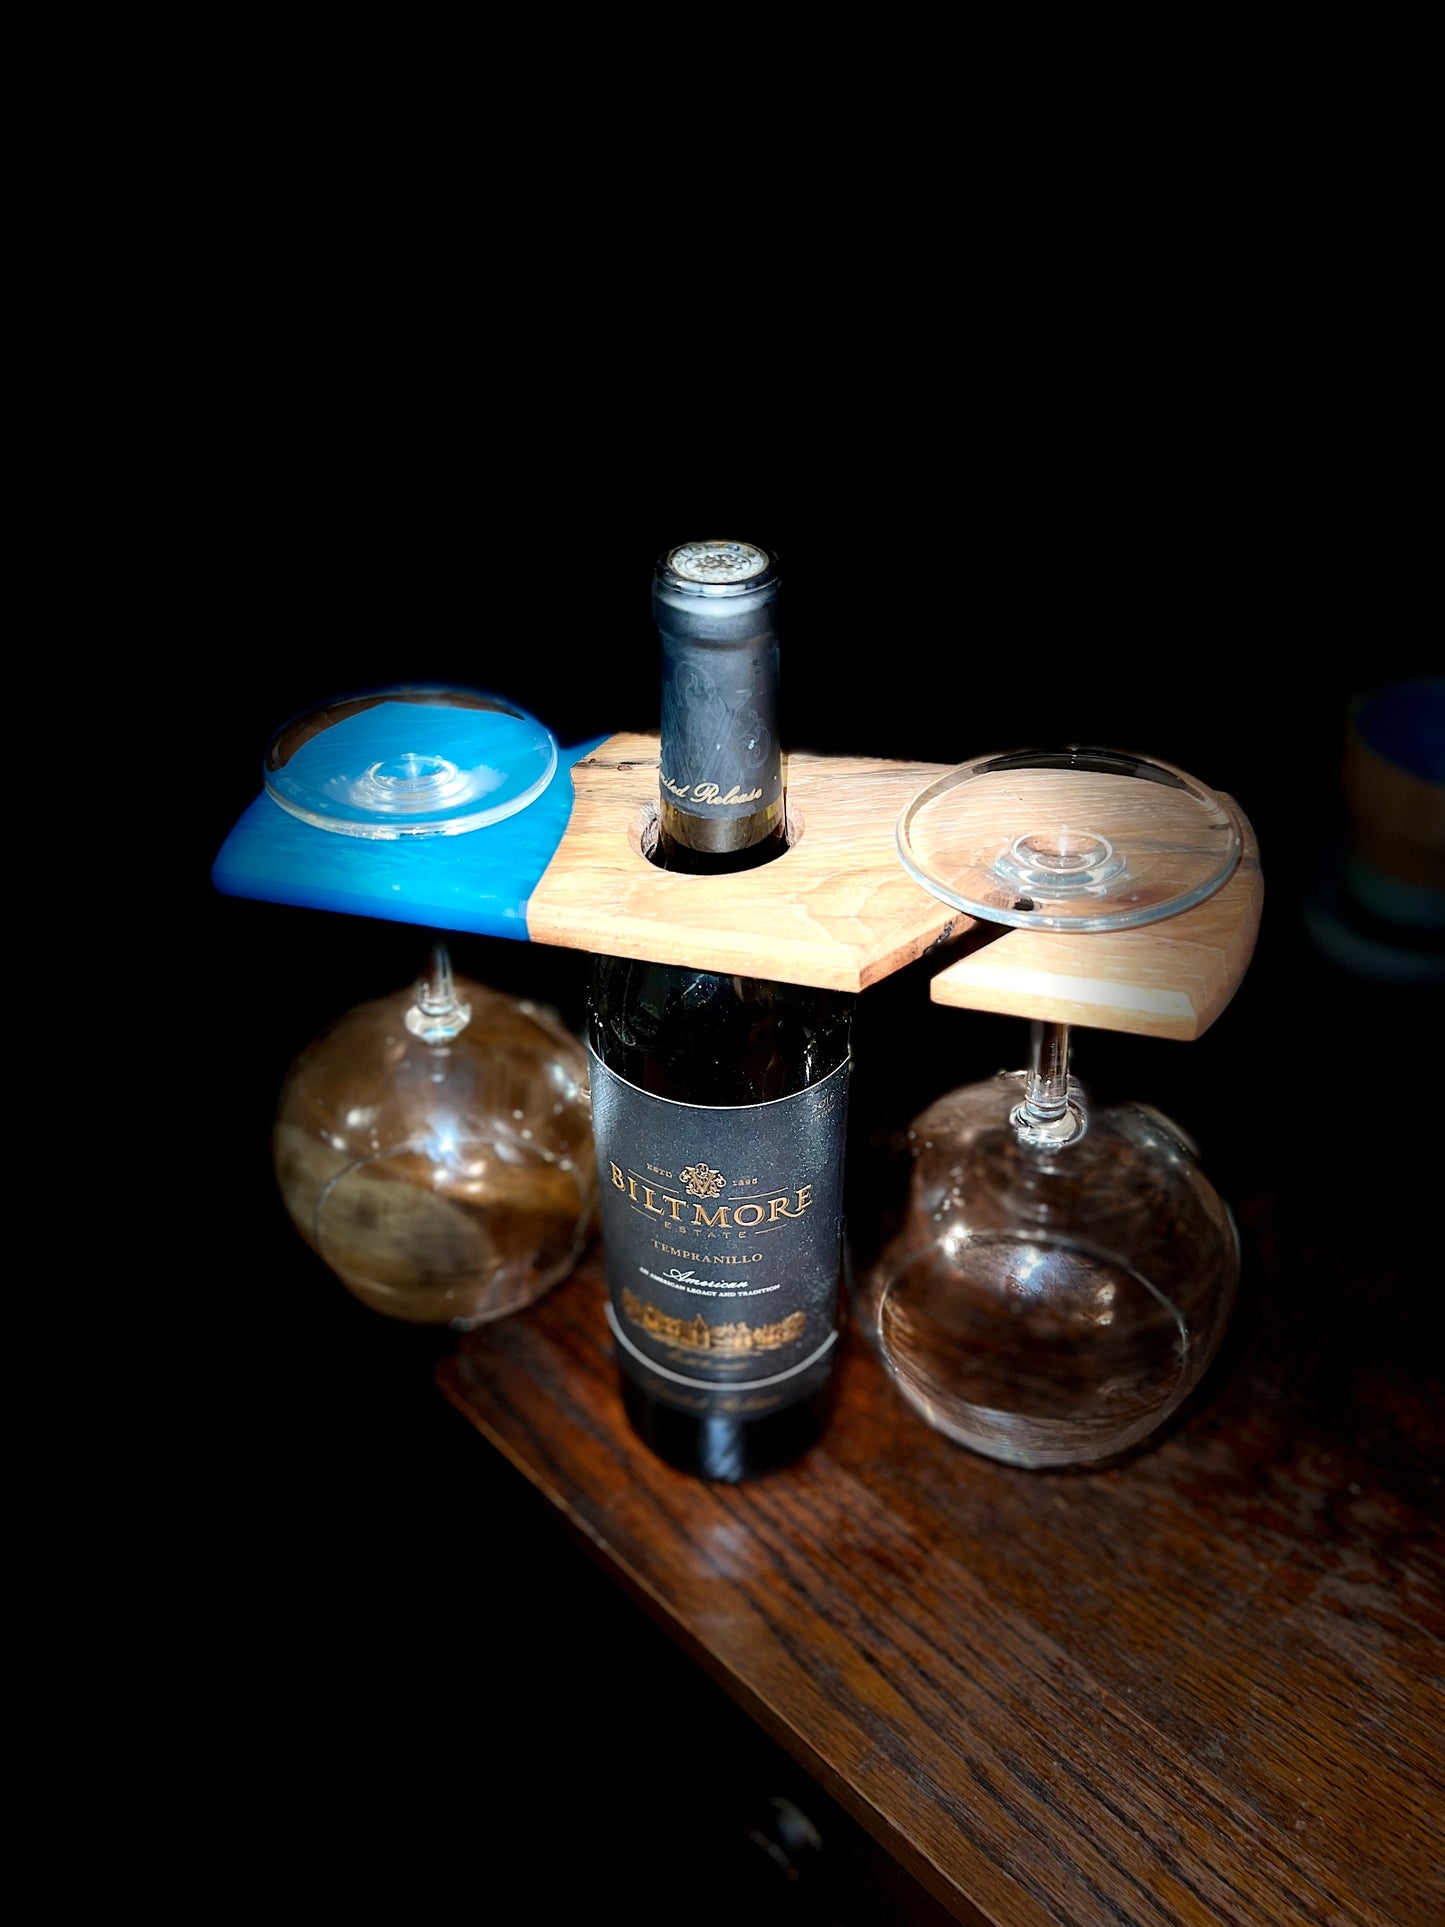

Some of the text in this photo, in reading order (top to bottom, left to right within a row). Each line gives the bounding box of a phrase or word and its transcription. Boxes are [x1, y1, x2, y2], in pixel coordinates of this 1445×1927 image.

[690, 782, 763, 806] Release
[609, 1160, 814, 1229] BILTMORE
[664, 1220, 747, 1239] ESTATE
[651, 1239, 763, 1264] TEMPRANILLO
[649, 1272, 686, 1292] AMERICAN
[686, 1286, 717, 1298] LEGACY
[737, 1283, 781, 1297] TRADITION
[662, 1268, 749, 1289] American
